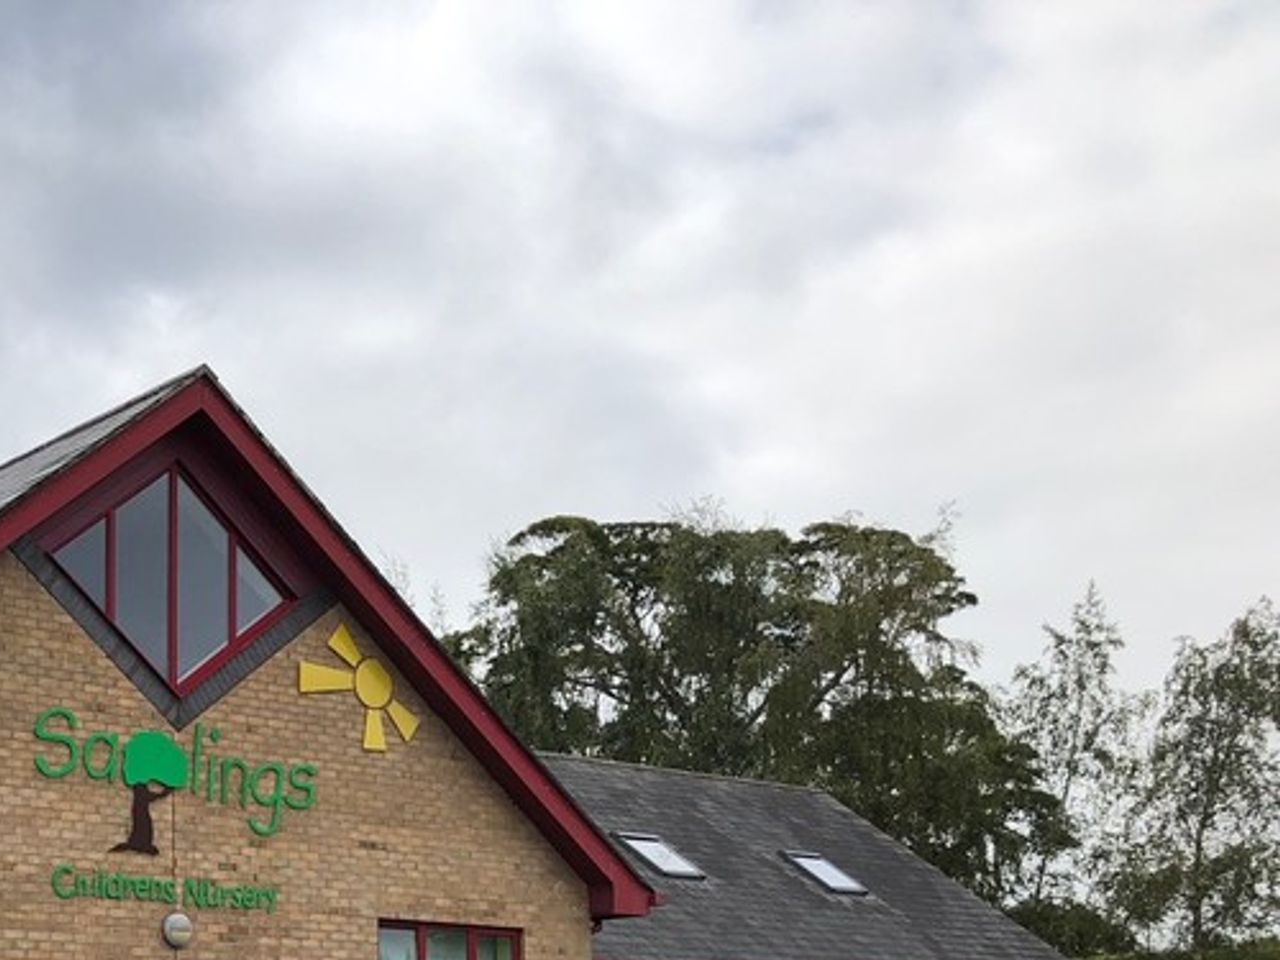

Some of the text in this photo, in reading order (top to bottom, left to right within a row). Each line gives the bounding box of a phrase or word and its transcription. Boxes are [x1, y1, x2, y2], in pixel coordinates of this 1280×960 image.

[33, 706, 318, 837] Salings
[51, 864, 278, 914] Childrens Nursery
